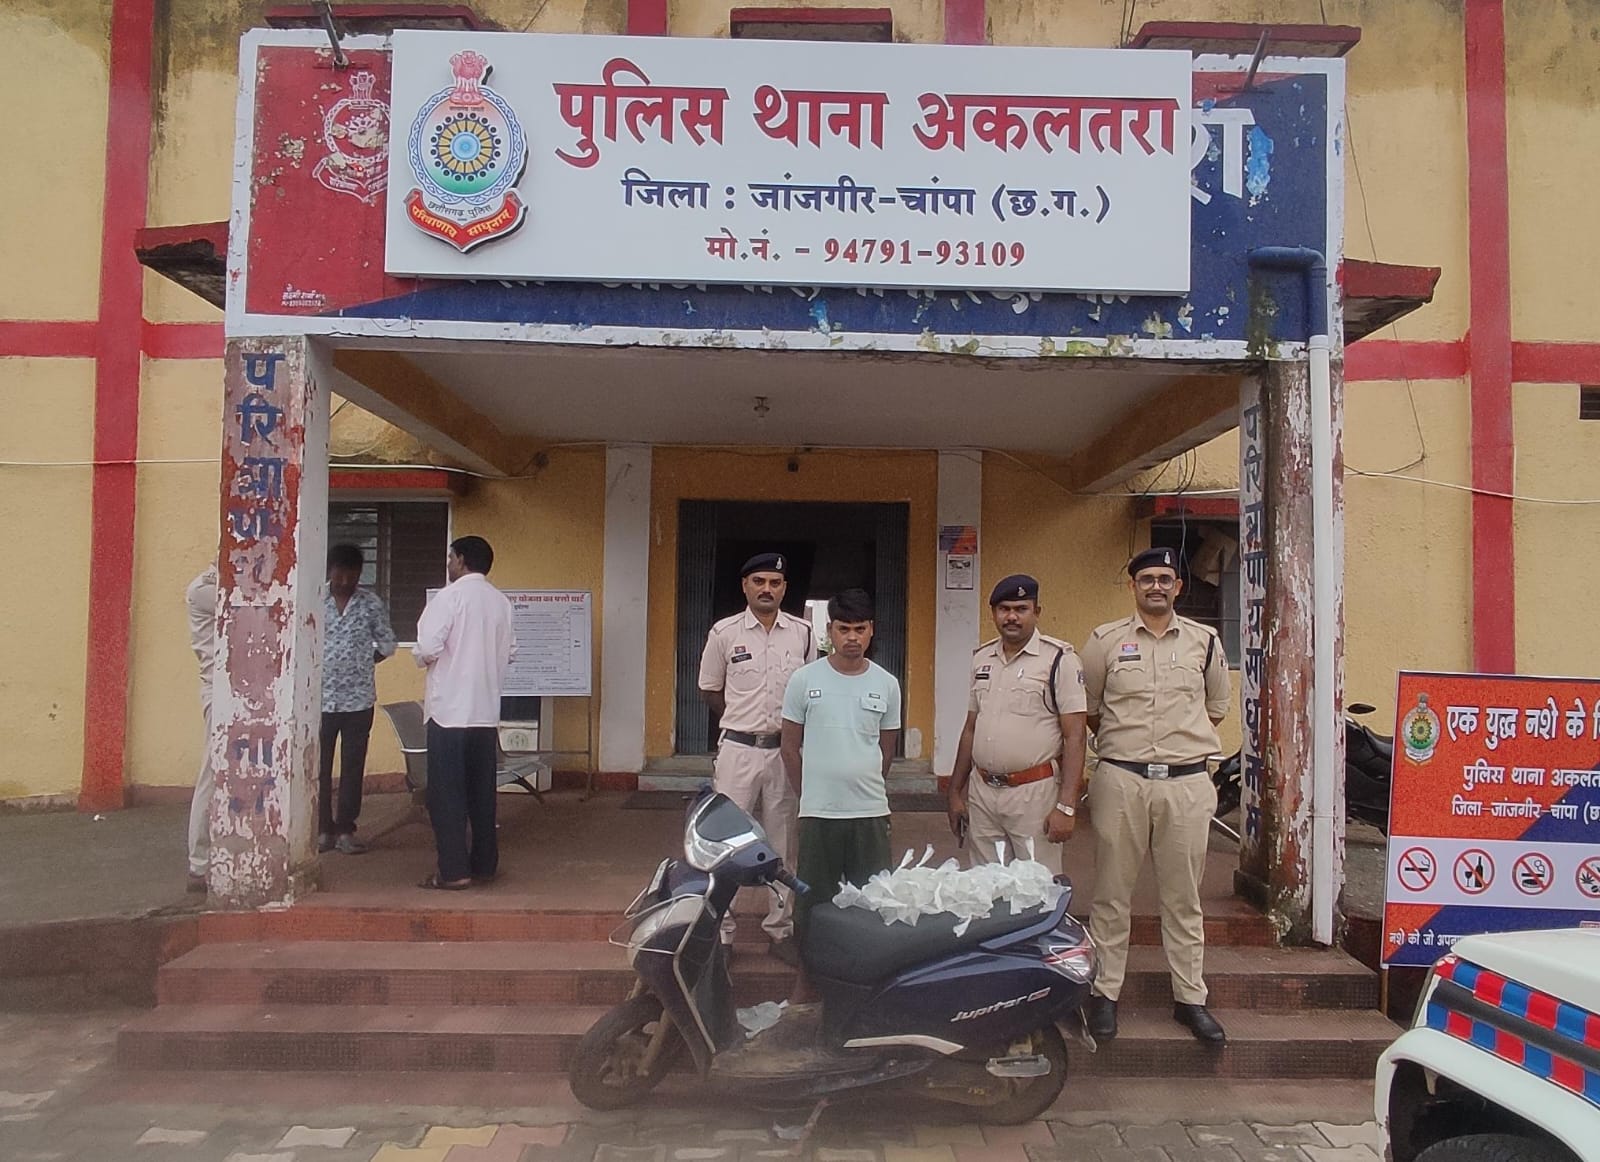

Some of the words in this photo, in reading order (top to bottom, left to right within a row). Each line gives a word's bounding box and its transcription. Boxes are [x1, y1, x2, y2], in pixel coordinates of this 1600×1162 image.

[552, 57, 730, 169] पुलिस
[753, 84, 890, 151] थाना
[911, 92, 1181, 156] अकलतरा
[620, 167, 710, 209] जिला
[747, 172, 977, 217] जांजगीर-चांपा
[991, 183, 1111, 224] (छ.ग.)
[704, 227, 781, 261] मो.नं.
[823, 237, 1026, 267] 94791-93109
[1446, 706, 1479, 741] एक
[1485, 707, 1518, 750] युद्ध
[1525, 697, 1557, 740] नशे
[1565, 698, 1586, 739] के
[1463, 758, 1505, 791] पुलिस
[1510, 767, 1545, 786] थाना
[1389, 927, 1405, 945] नशे
[1408, 929, 1420, 945] को
[1423, 929, 1434, 945] जो
[950, 995, 1028, 1022] Jupiter
